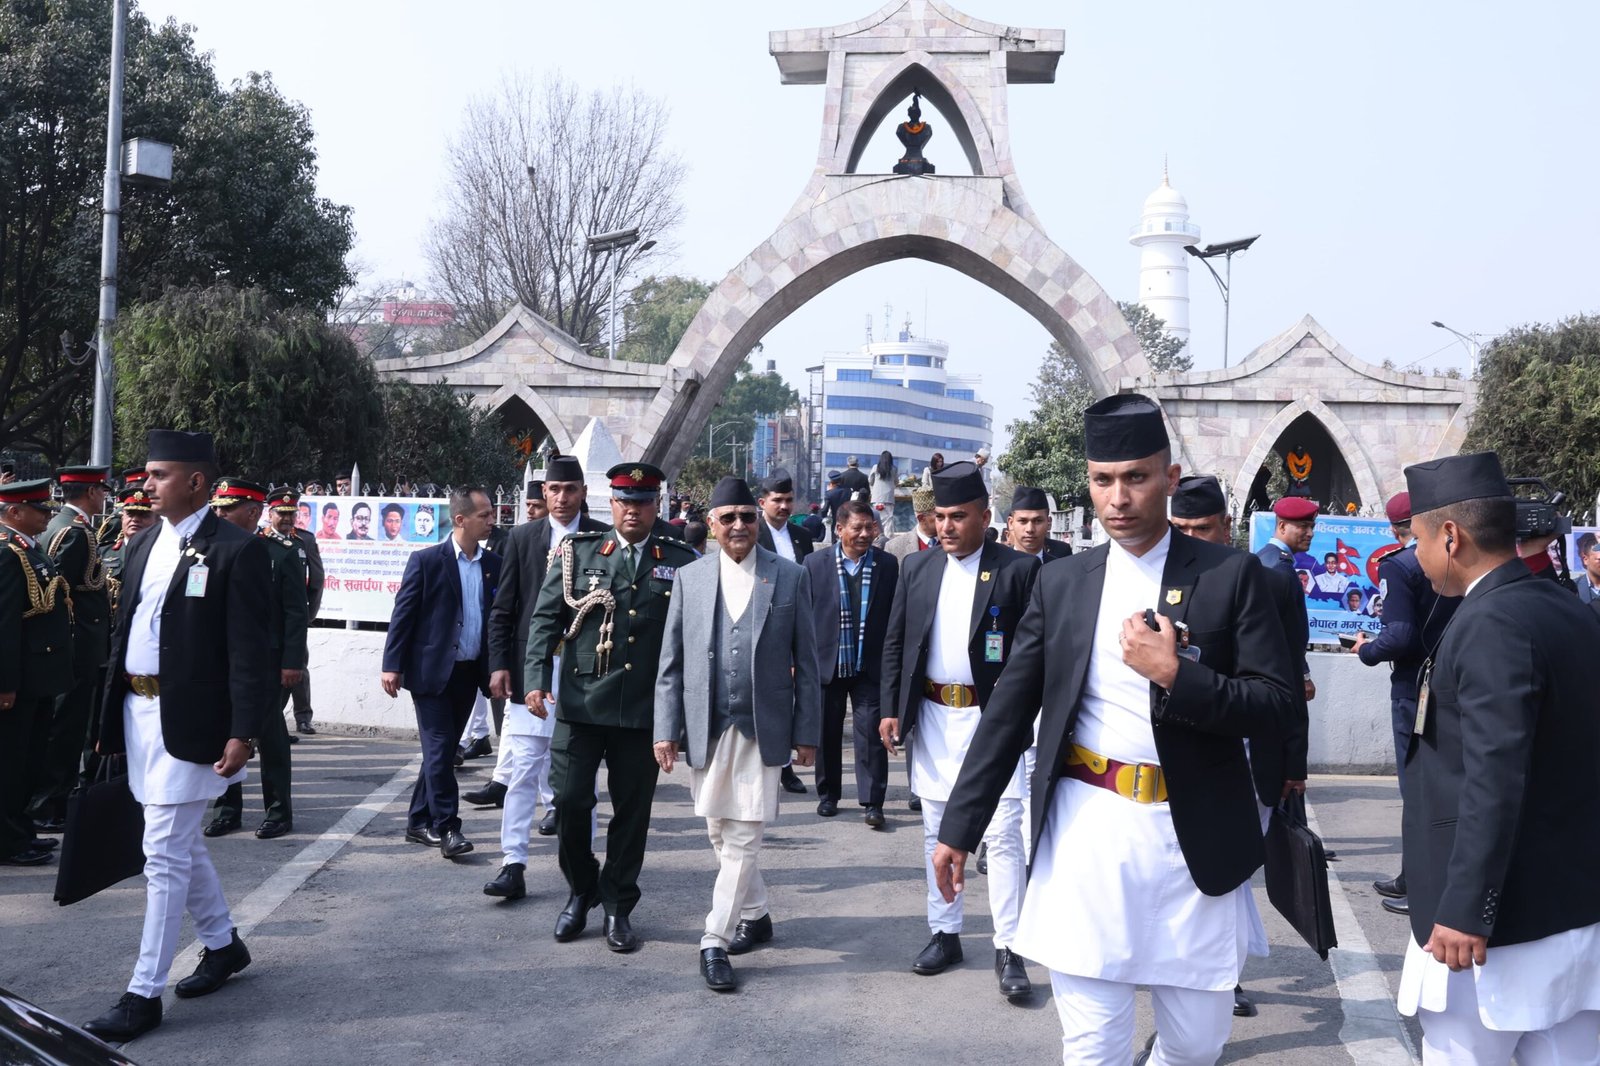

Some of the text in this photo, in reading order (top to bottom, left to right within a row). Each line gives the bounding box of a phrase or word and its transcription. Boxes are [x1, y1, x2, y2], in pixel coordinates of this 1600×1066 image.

[417, 309, 444, 318] MALL
[1352, 525, 1376, 536] अमर
[344, 577, 384, 592] समर्पण
[1310, 617, 1337, 629] नेपाल
[1341, 620, 1364, 630] मगर
